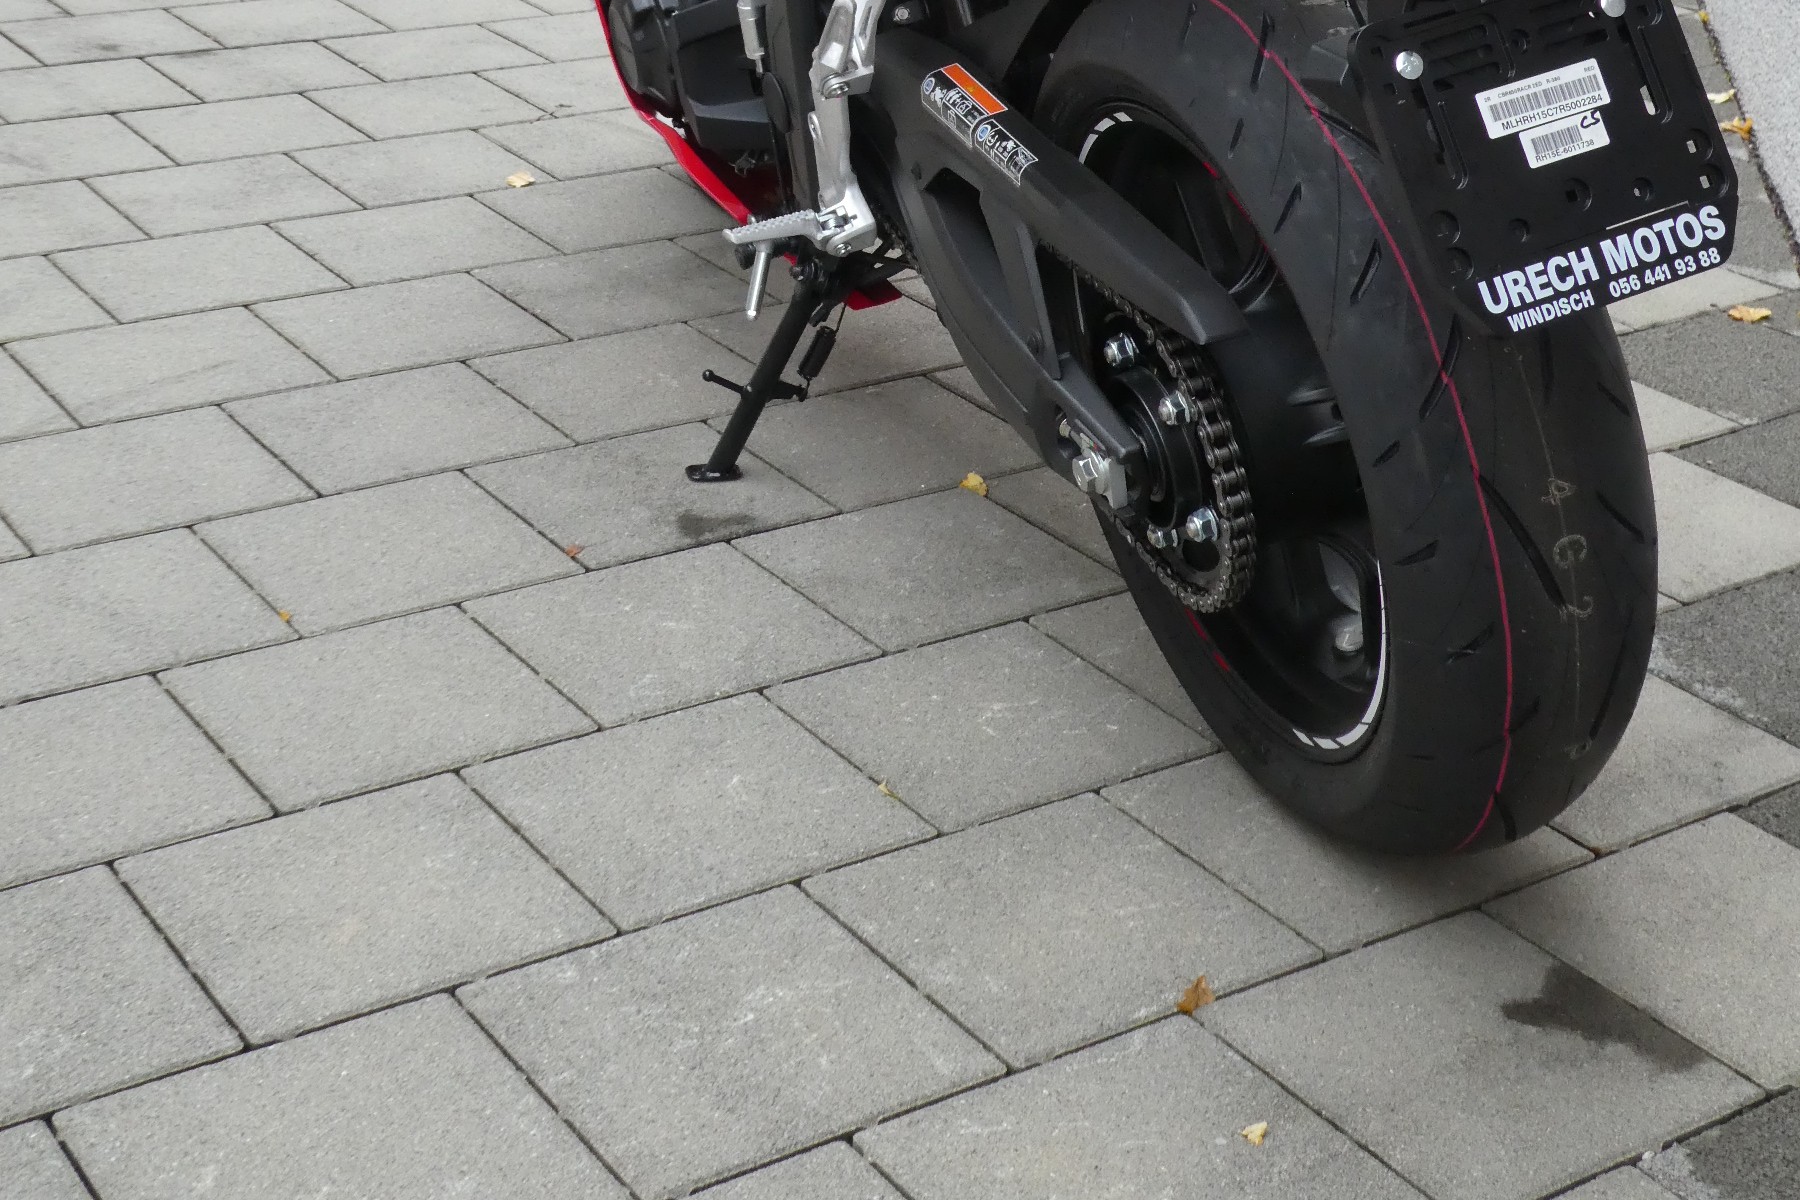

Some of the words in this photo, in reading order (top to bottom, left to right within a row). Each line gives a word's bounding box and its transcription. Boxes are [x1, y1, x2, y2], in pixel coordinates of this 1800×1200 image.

[1501, 93, 1603, 131] MLHRH15C7R5002284
[1535, 138, 1595, 163] RH15E-6011738
[1477, 246, 1600, 315] URECH
[1599, 205, 1726, 275] MOTOS
[1609, 274, 1641, 298] 056
[1644, 263, 1672, 285] 441
[1674, 255, 1697, 276] 93
[1698, 247, 1721, 267] 88
[1507, 289, 1595, 332] WINDISCH
